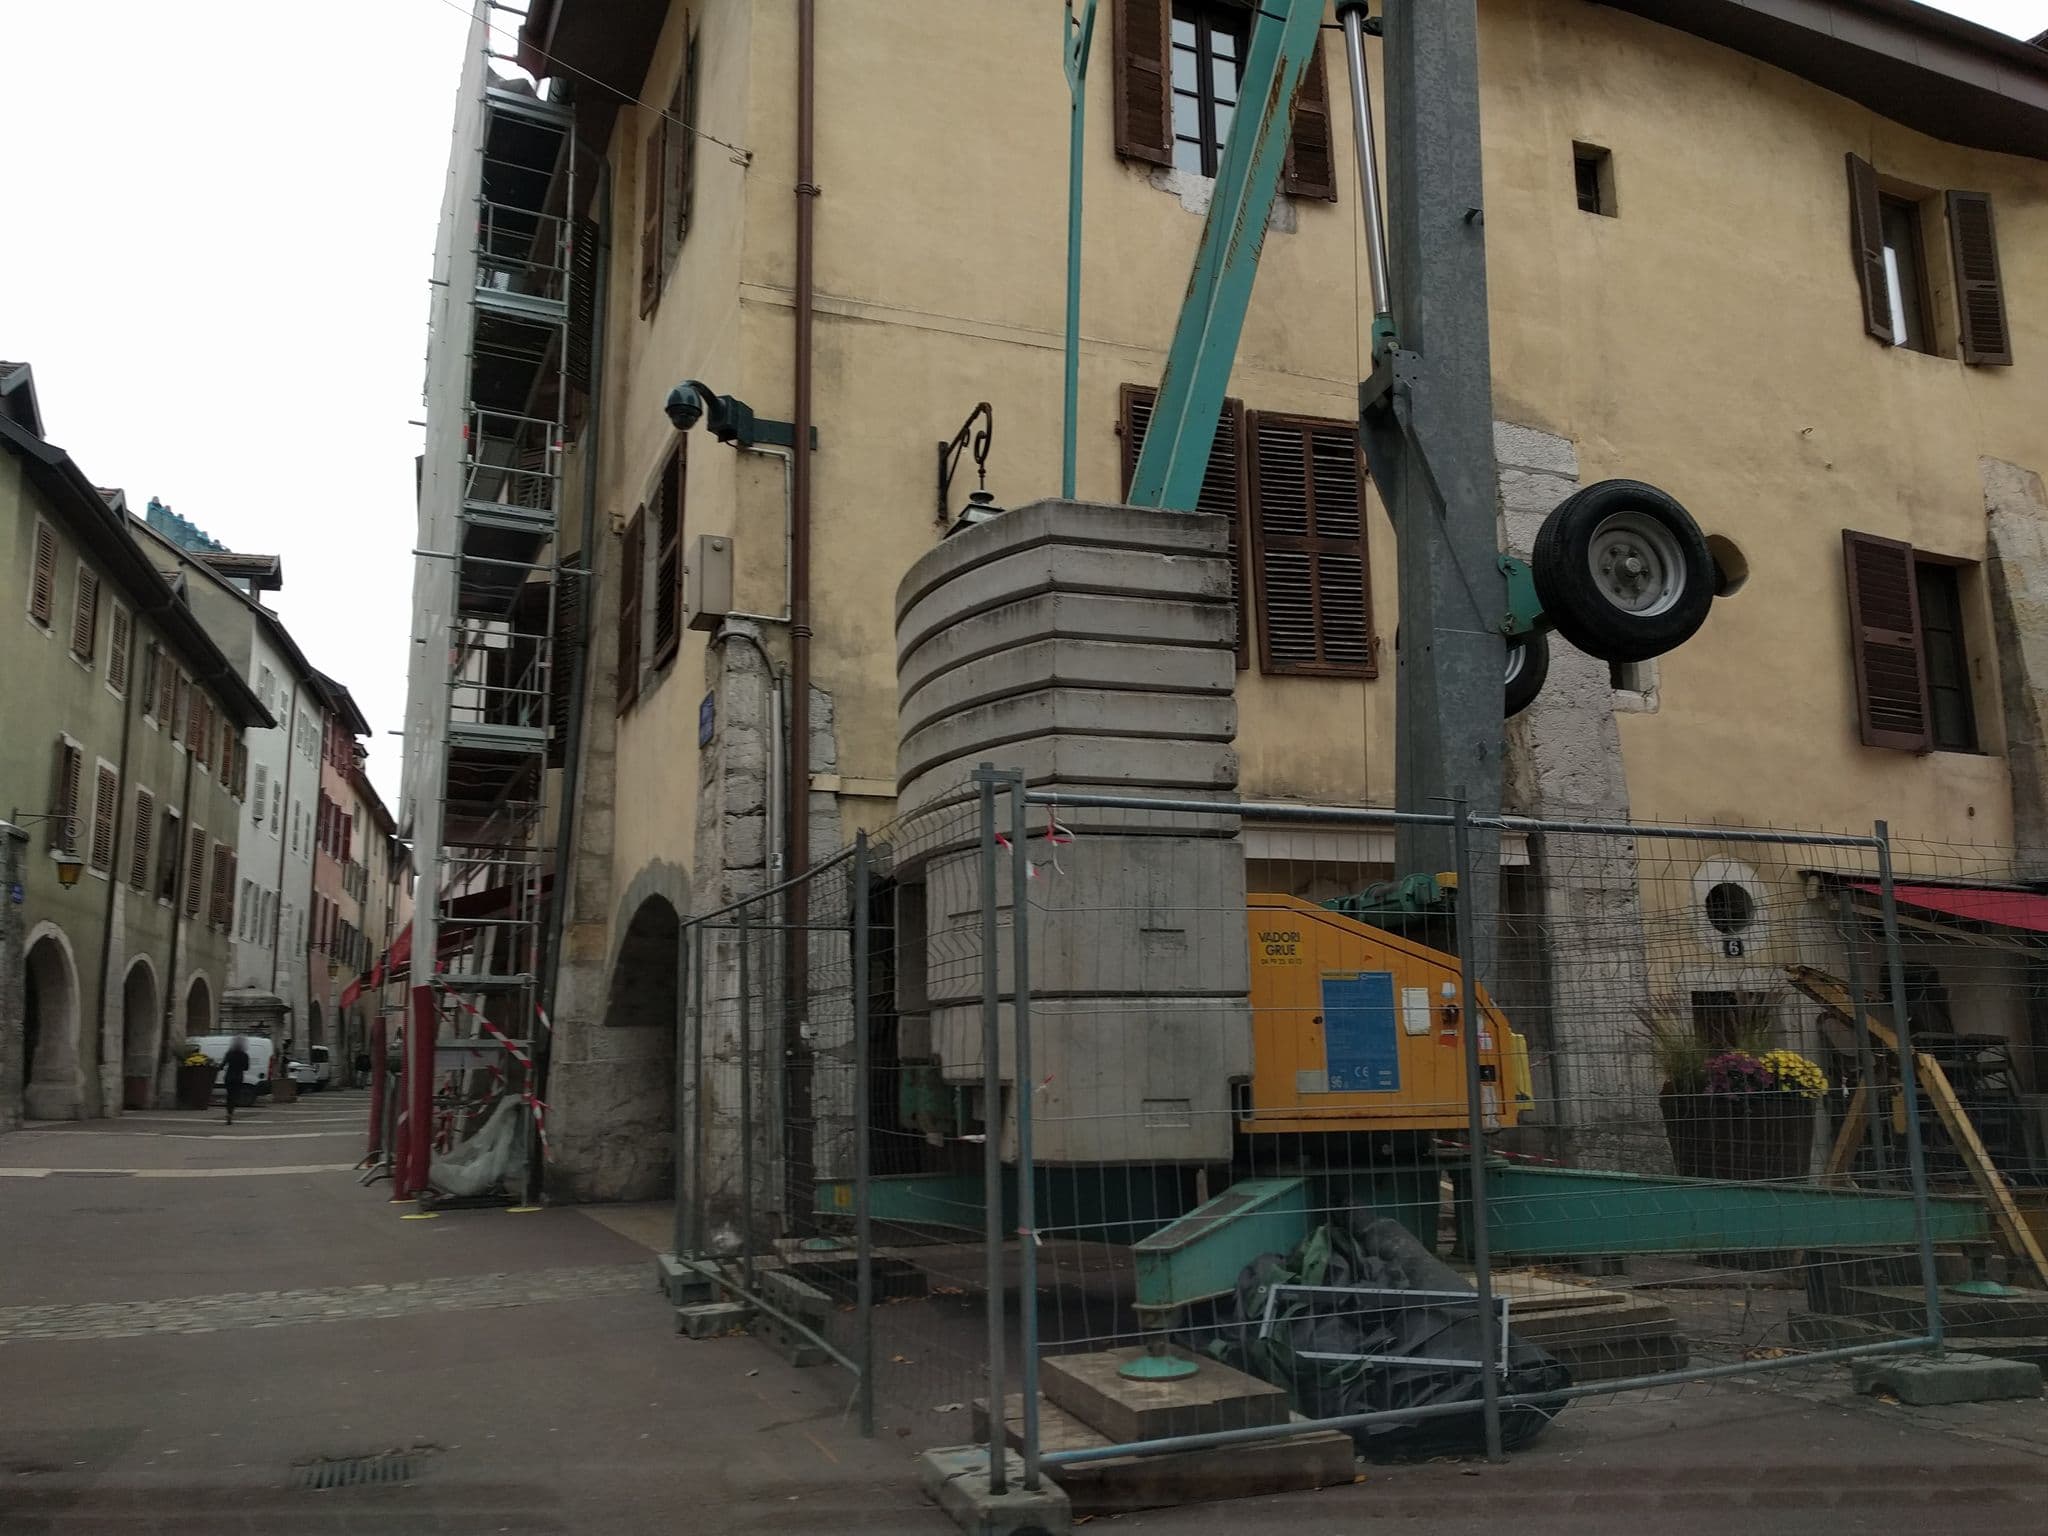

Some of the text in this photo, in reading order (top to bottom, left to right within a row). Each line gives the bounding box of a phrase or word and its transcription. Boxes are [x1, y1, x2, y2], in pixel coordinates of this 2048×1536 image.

[1265, 944, 1296, 956] GRUE
[1728, 940, 1740, 955] 6
[1354, 1066, 1369, 1078] CE
